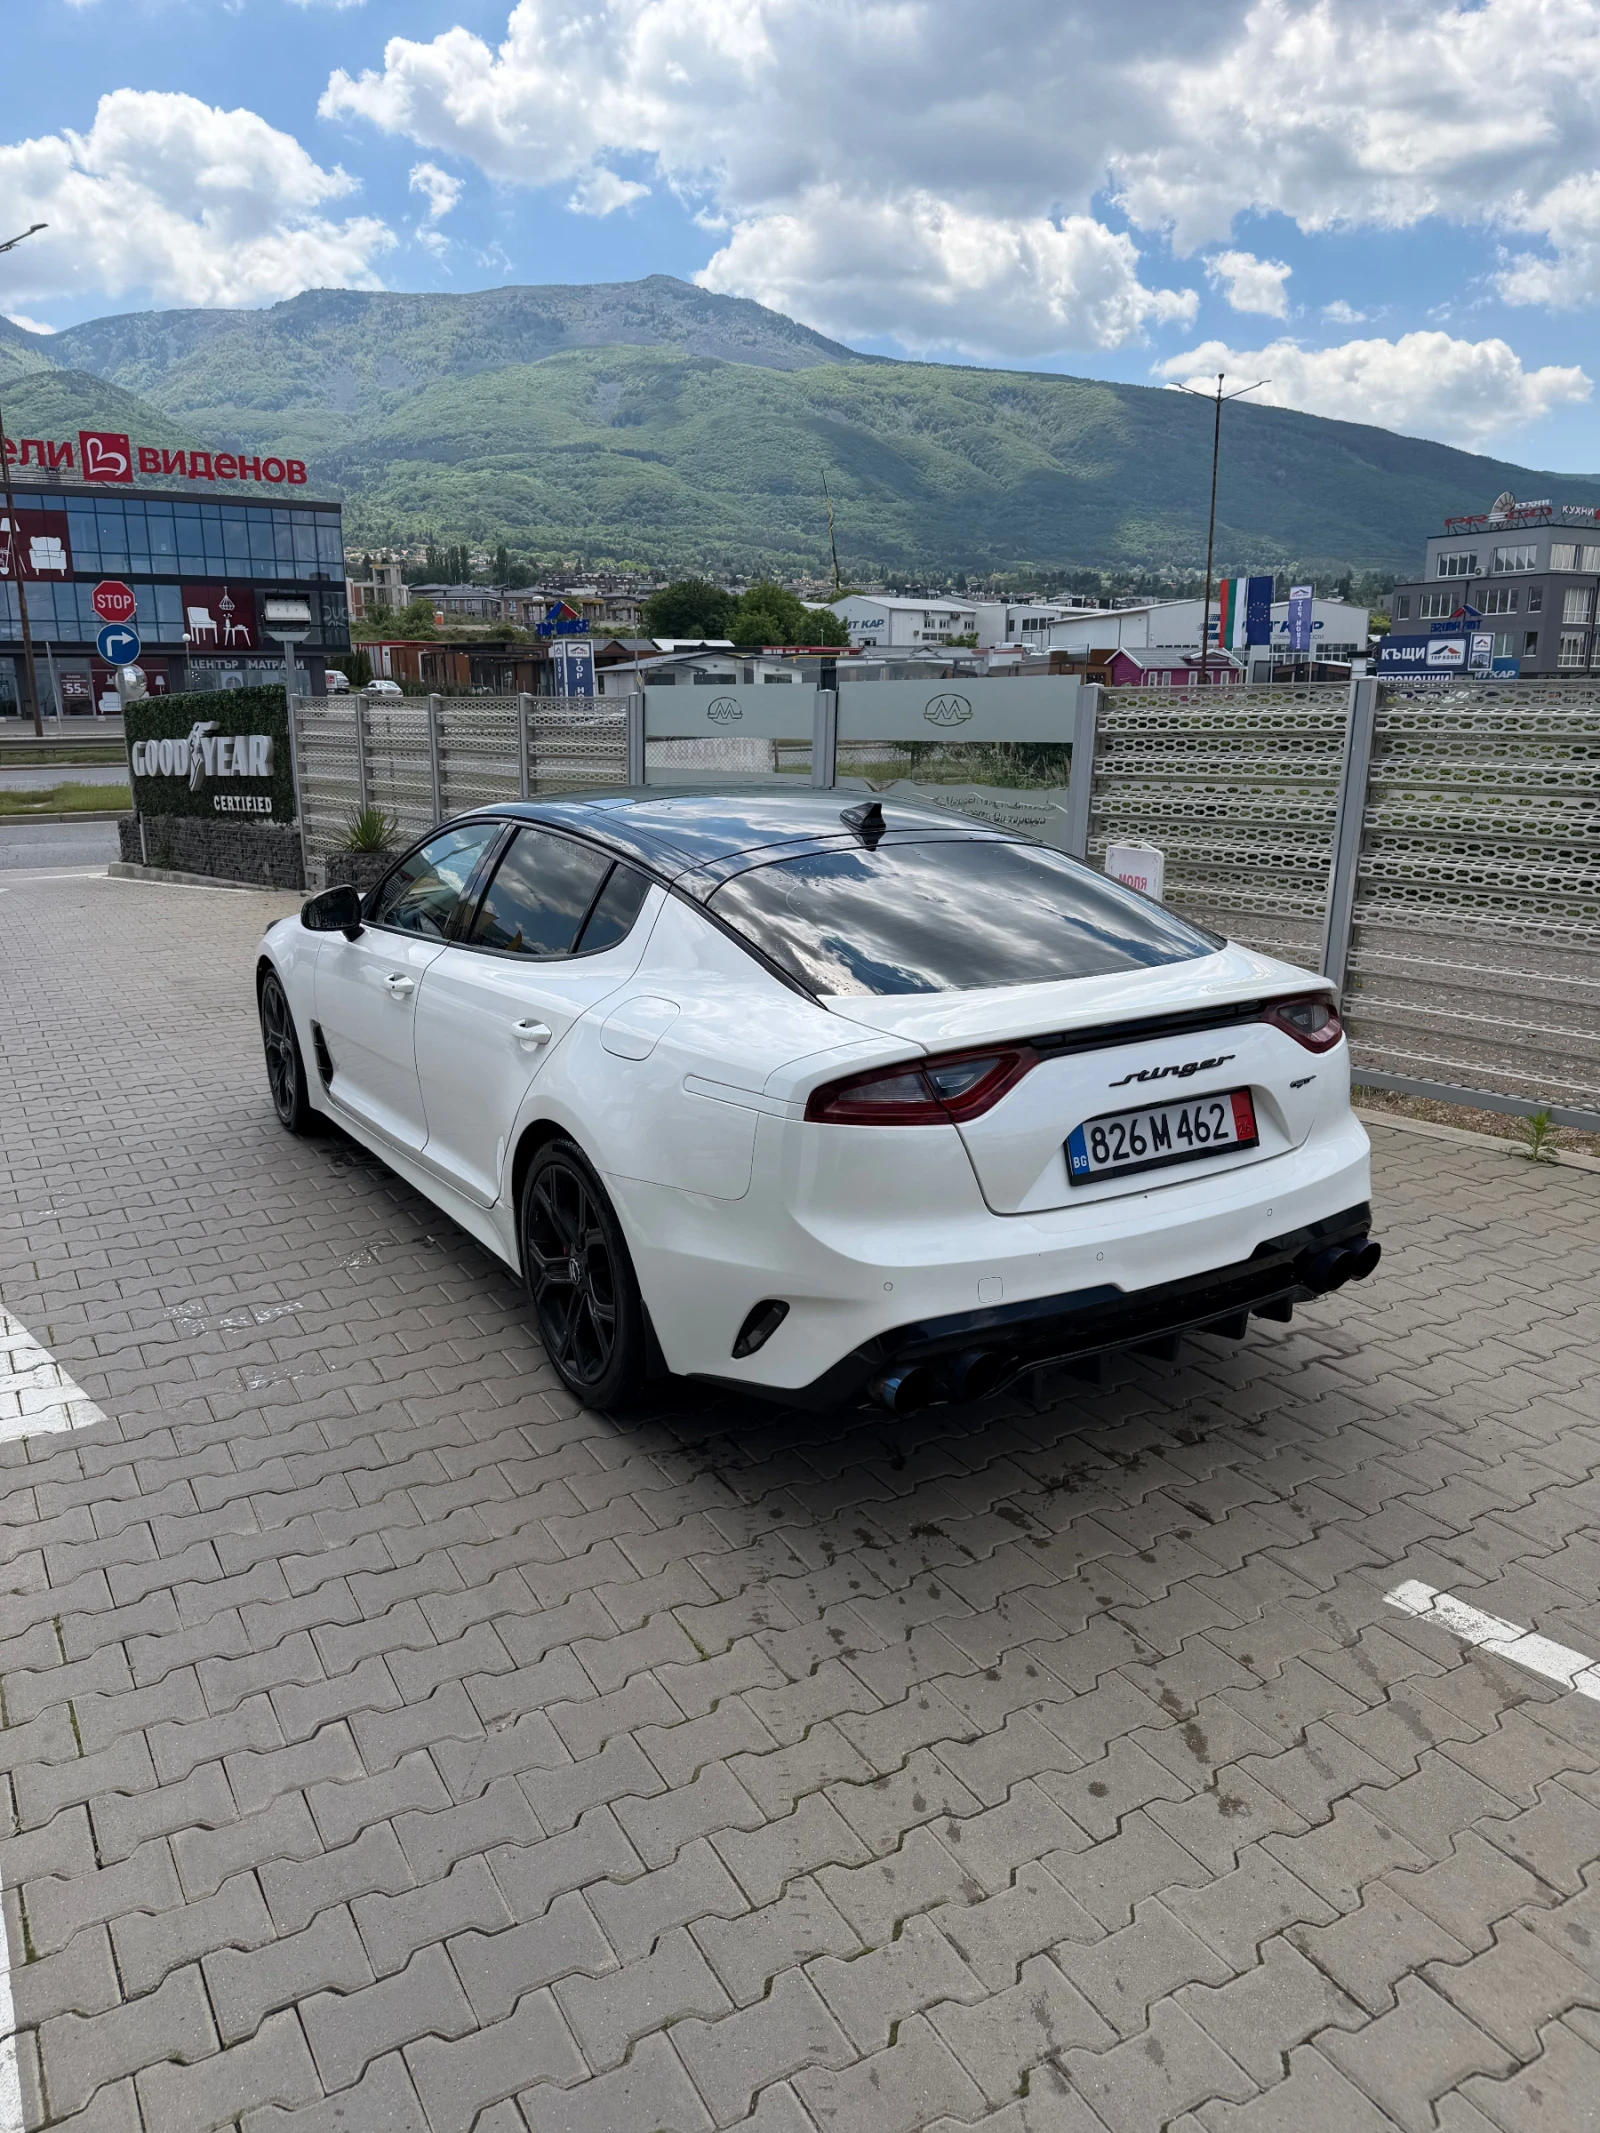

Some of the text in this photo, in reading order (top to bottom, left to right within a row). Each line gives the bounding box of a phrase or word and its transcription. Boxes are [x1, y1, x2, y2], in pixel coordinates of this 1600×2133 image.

[138, 447, 307, 485] виденов
[1562, 505, 1594, 516] КУХНИ
[97, 594, 132, 609] STOP
[861, 619, 884, 629] КАР
[1381, 647, 1425, 661] КЪЩИ
[190, 660, 305, 669] ЦЕНТЪР МАТРАИ
[214, 795, 272, 813] CERTIFIED
[1073, 1156, 1087, 1169] BG
[1091, 1118, 1147, 1164] 826
[1149, 1113, 1172, 1152] M
[1177, 1103, 1229, 1146] 462
